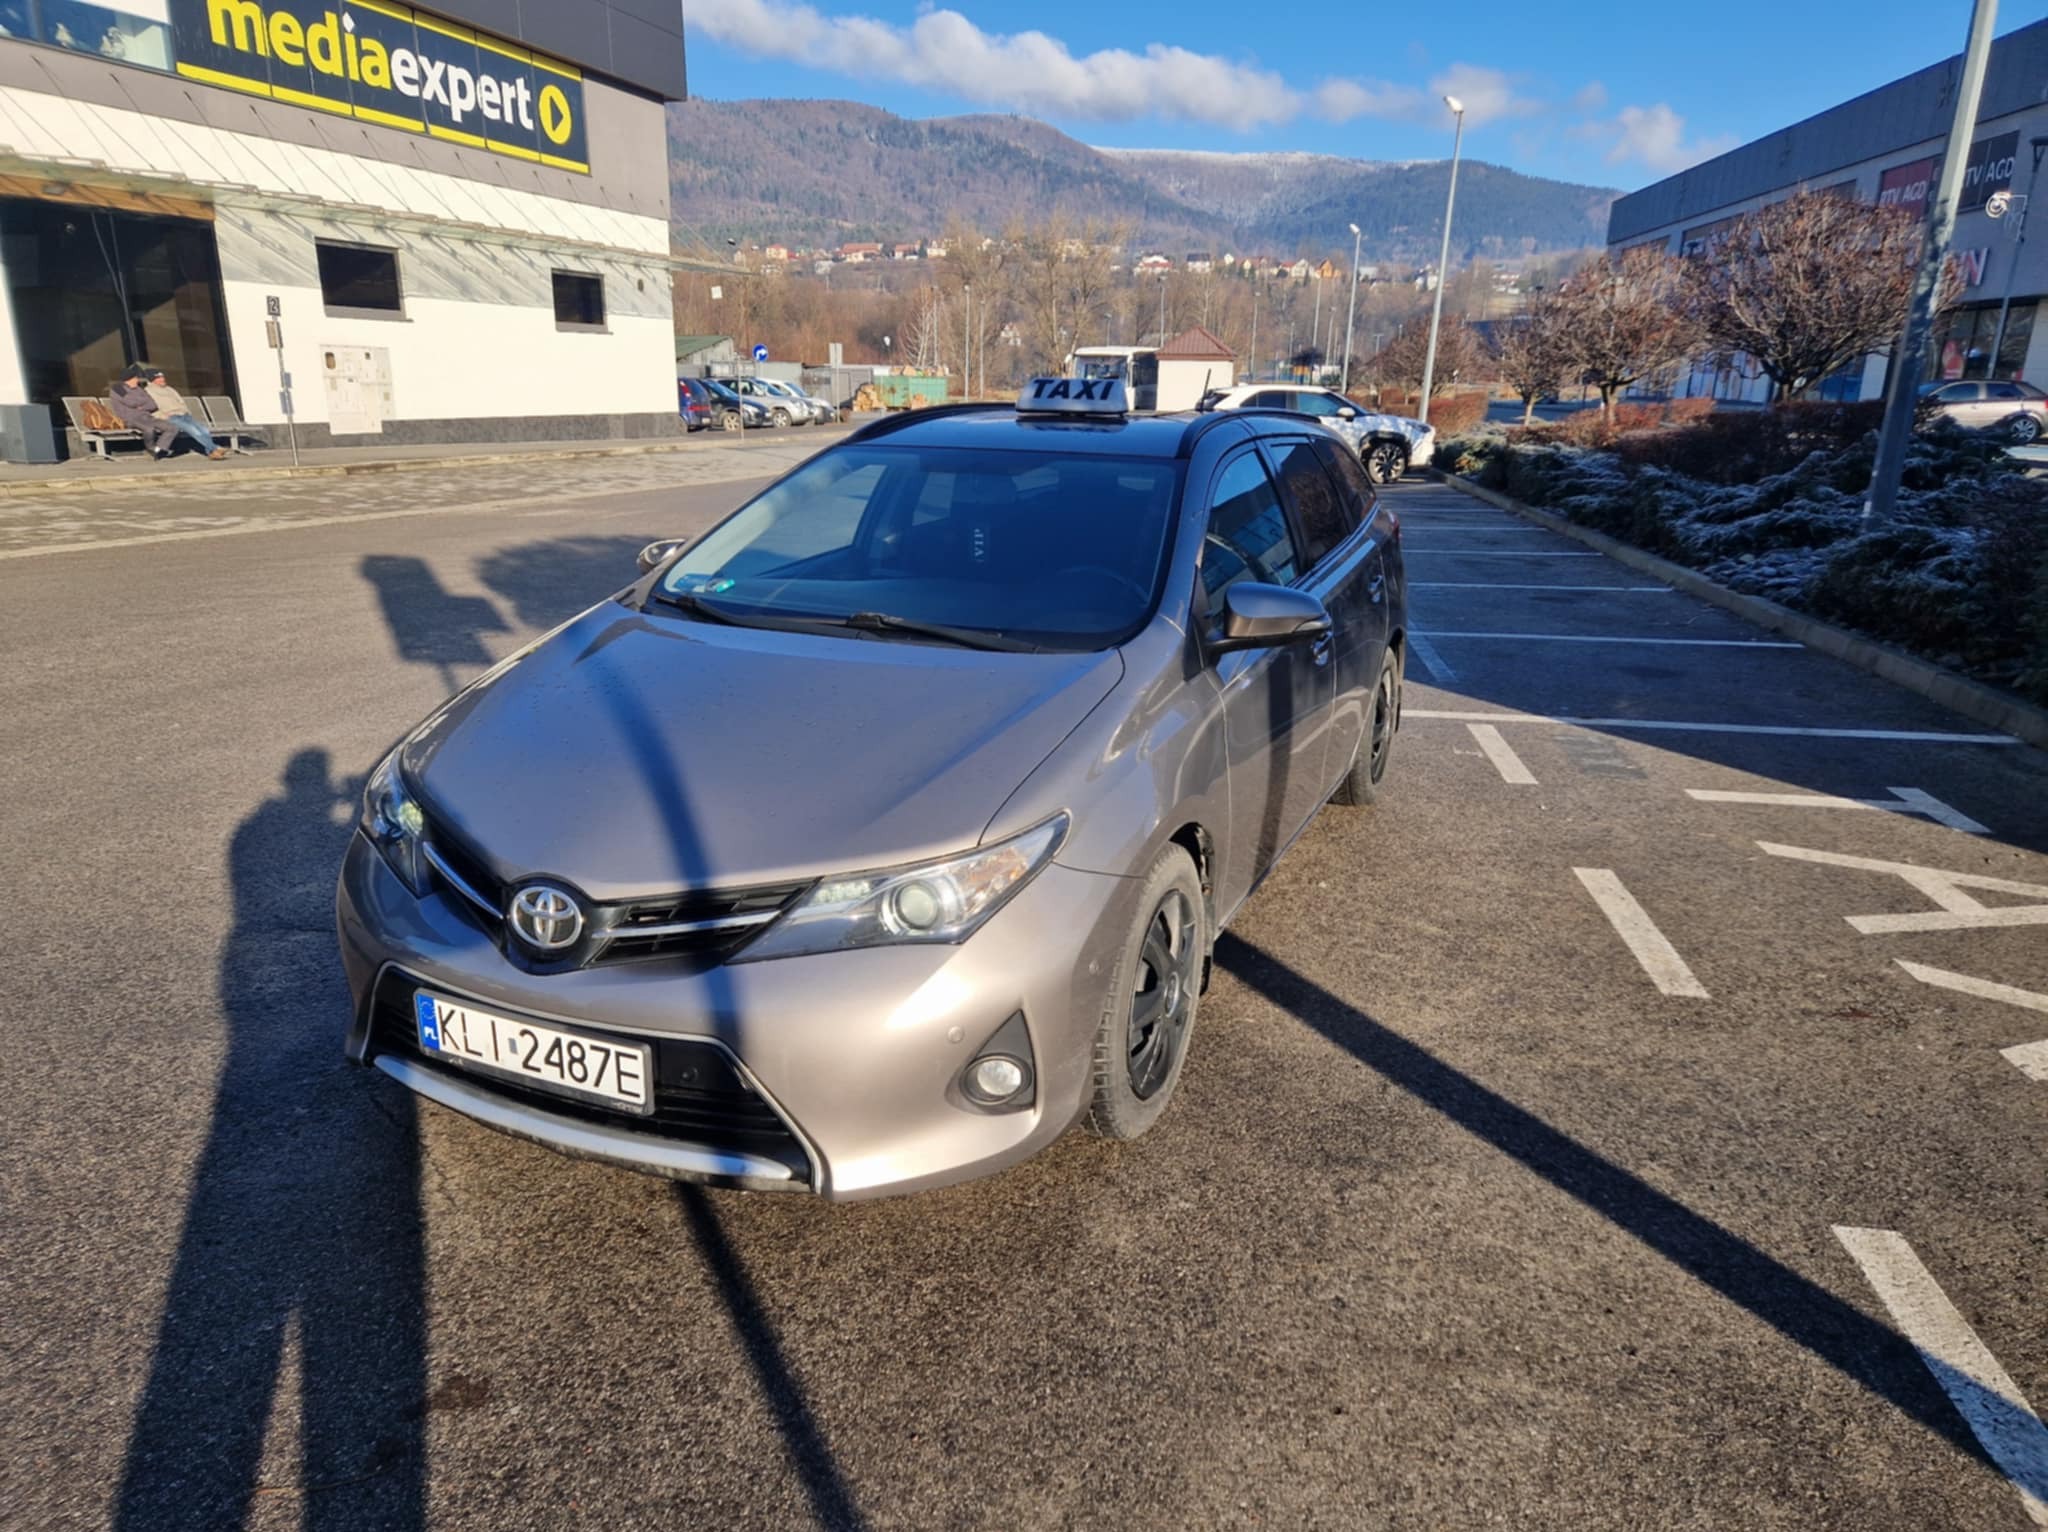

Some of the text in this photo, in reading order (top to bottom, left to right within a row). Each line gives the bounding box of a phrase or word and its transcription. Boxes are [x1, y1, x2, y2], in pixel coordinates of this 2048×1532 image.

[1985, 156, 2015, 182] AGD
[1902, 180, 1927, 202] AGD
[269, 299, 278, 314] 2
[1033, 379, 1115, 401] TAXI
[424, 1026, 438, 1041] PL
[438, 1005, 641, 1099] KLI 2487E
